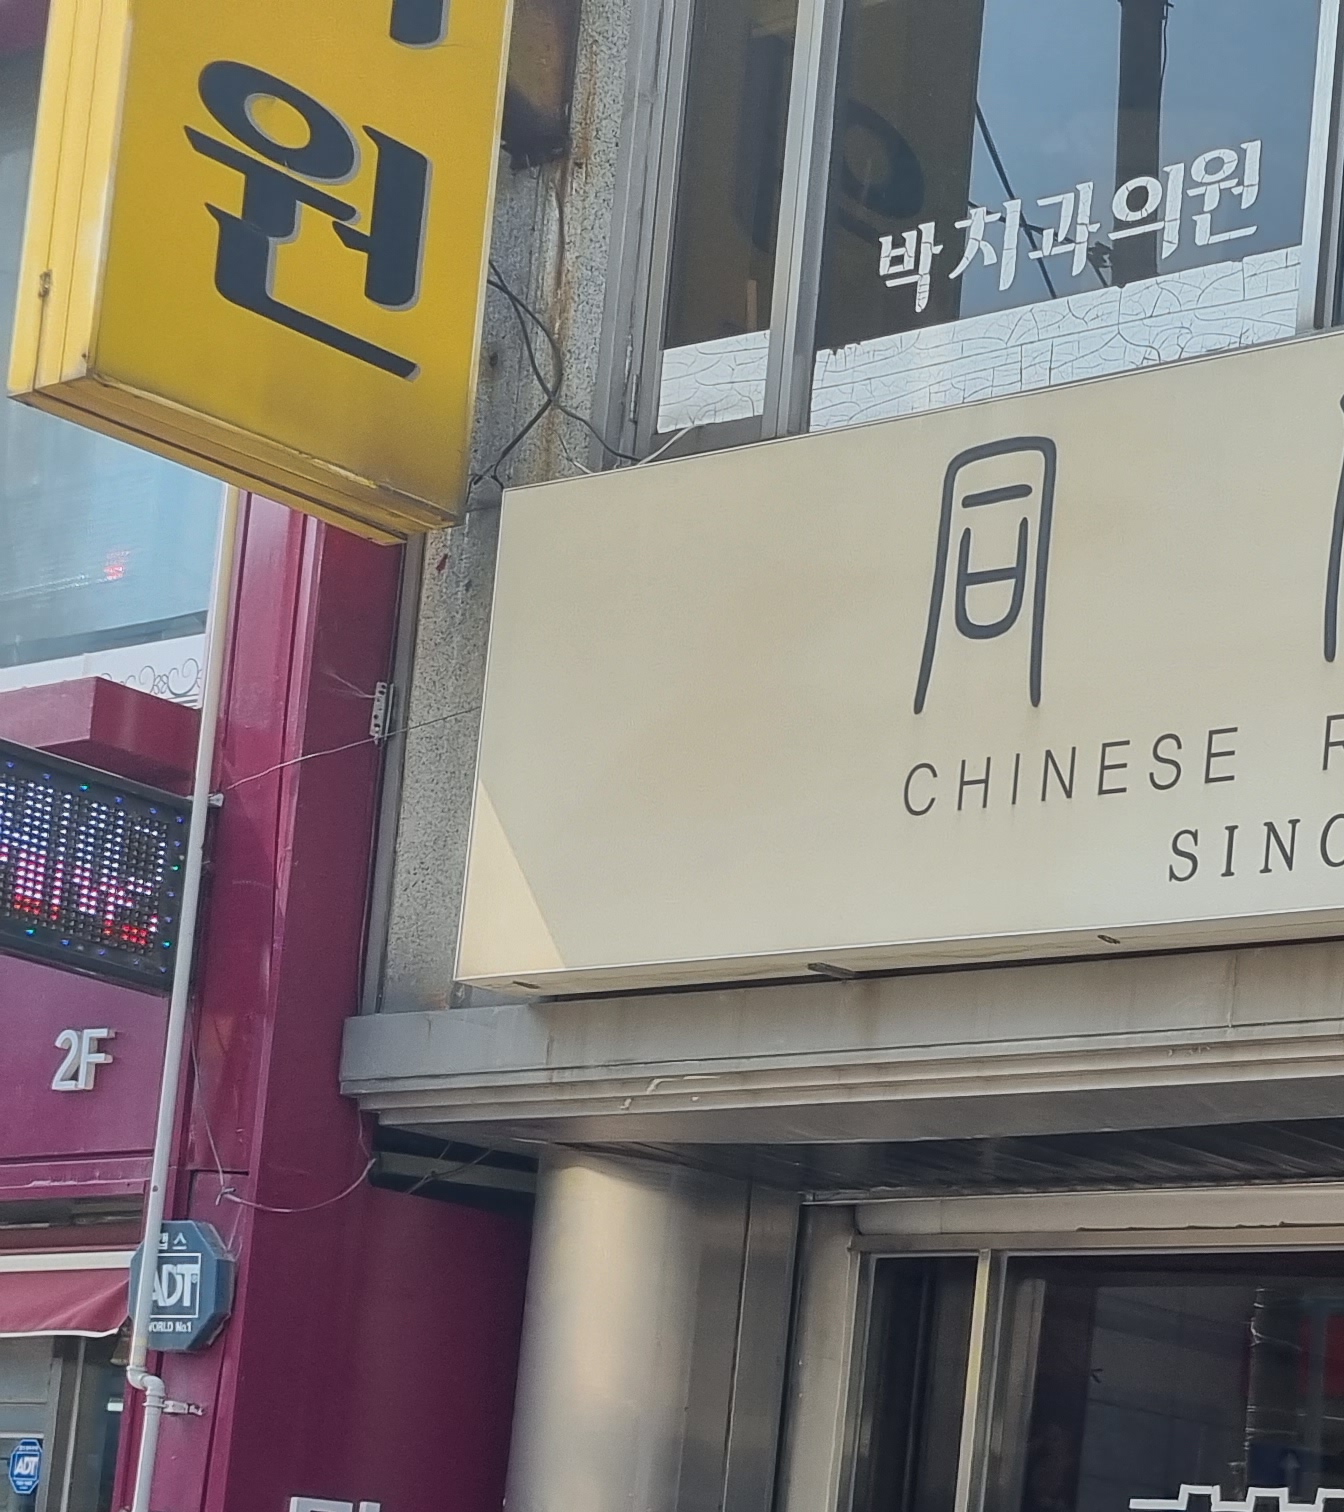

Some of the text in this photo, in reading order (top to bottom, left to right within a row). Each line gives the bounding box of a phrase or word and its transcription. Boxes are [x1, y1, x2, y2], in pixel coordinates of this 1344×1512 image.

[183, 0, 445, 380] 원
[877, 139, 1262, 313] 박치과의원
[903, 727, 1239, 817] CHINESE
[51, 1027, 116, 1091] 2F
[148, 1321, 174, 1332] ORLD
[14, 1456, 39, 1476] ADT
